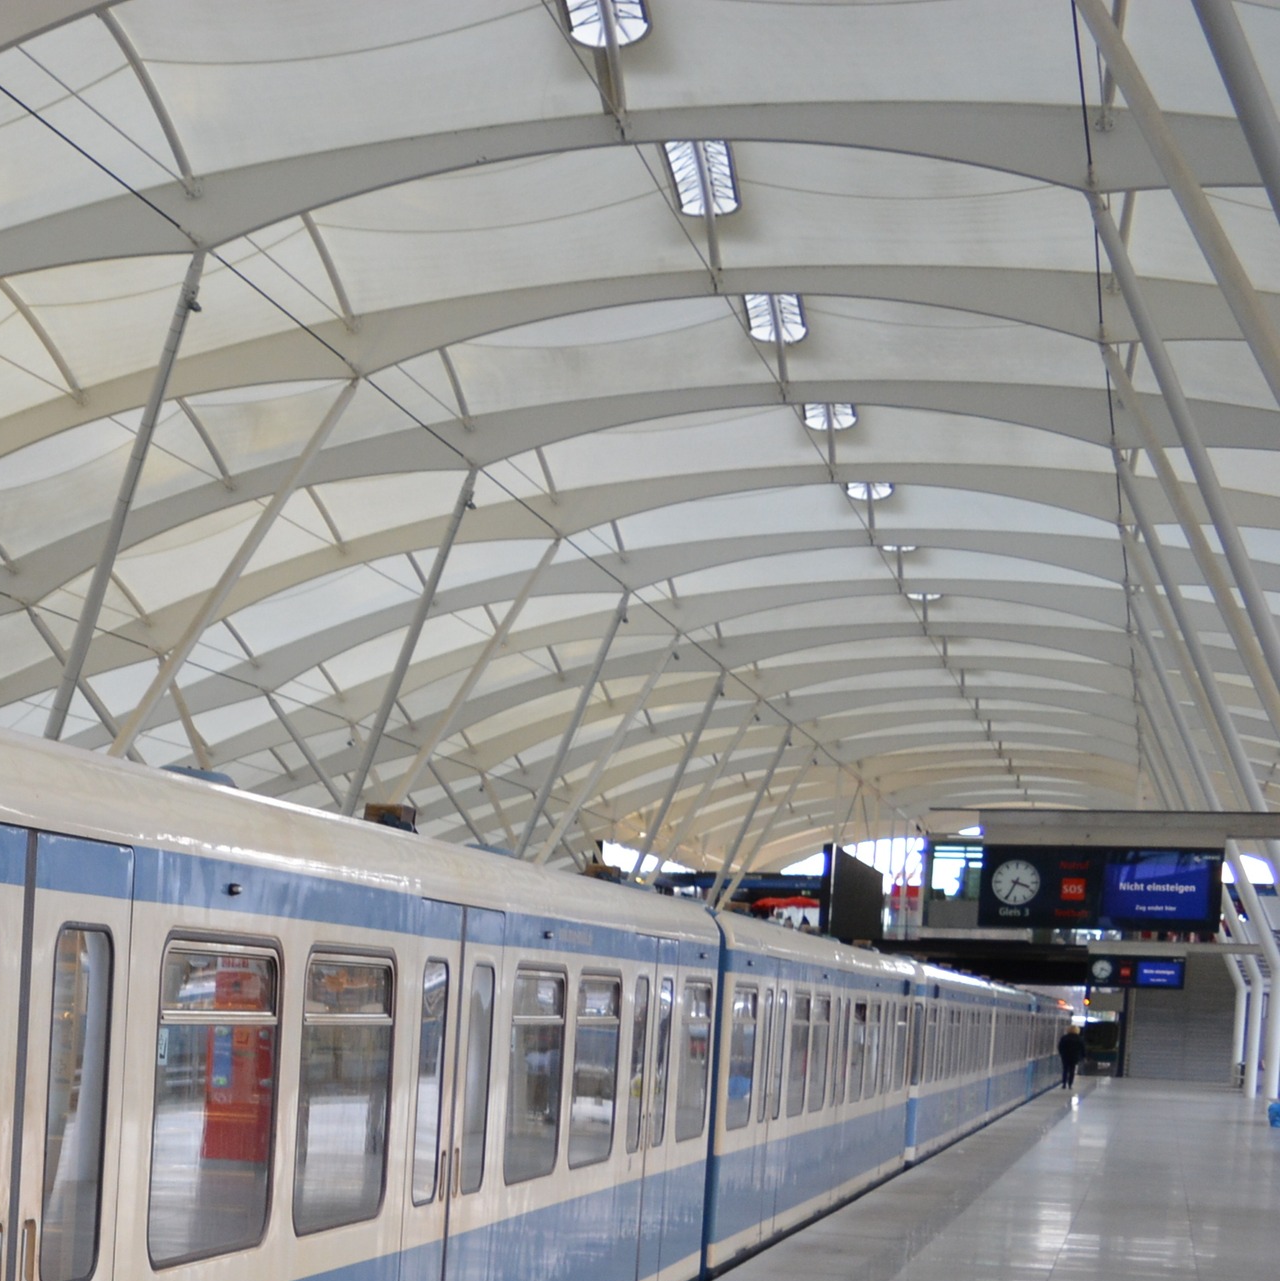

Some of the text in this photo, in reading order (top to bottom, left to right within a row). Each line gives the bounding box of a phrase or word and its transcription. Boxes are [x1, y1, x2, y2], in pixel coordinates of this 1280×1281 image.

[1062, 884, 1084, 895] SOS
[1119, 882, 1196, 894] Nicht einsteigen
[998, 906, 1030, 917] Gleis 3
